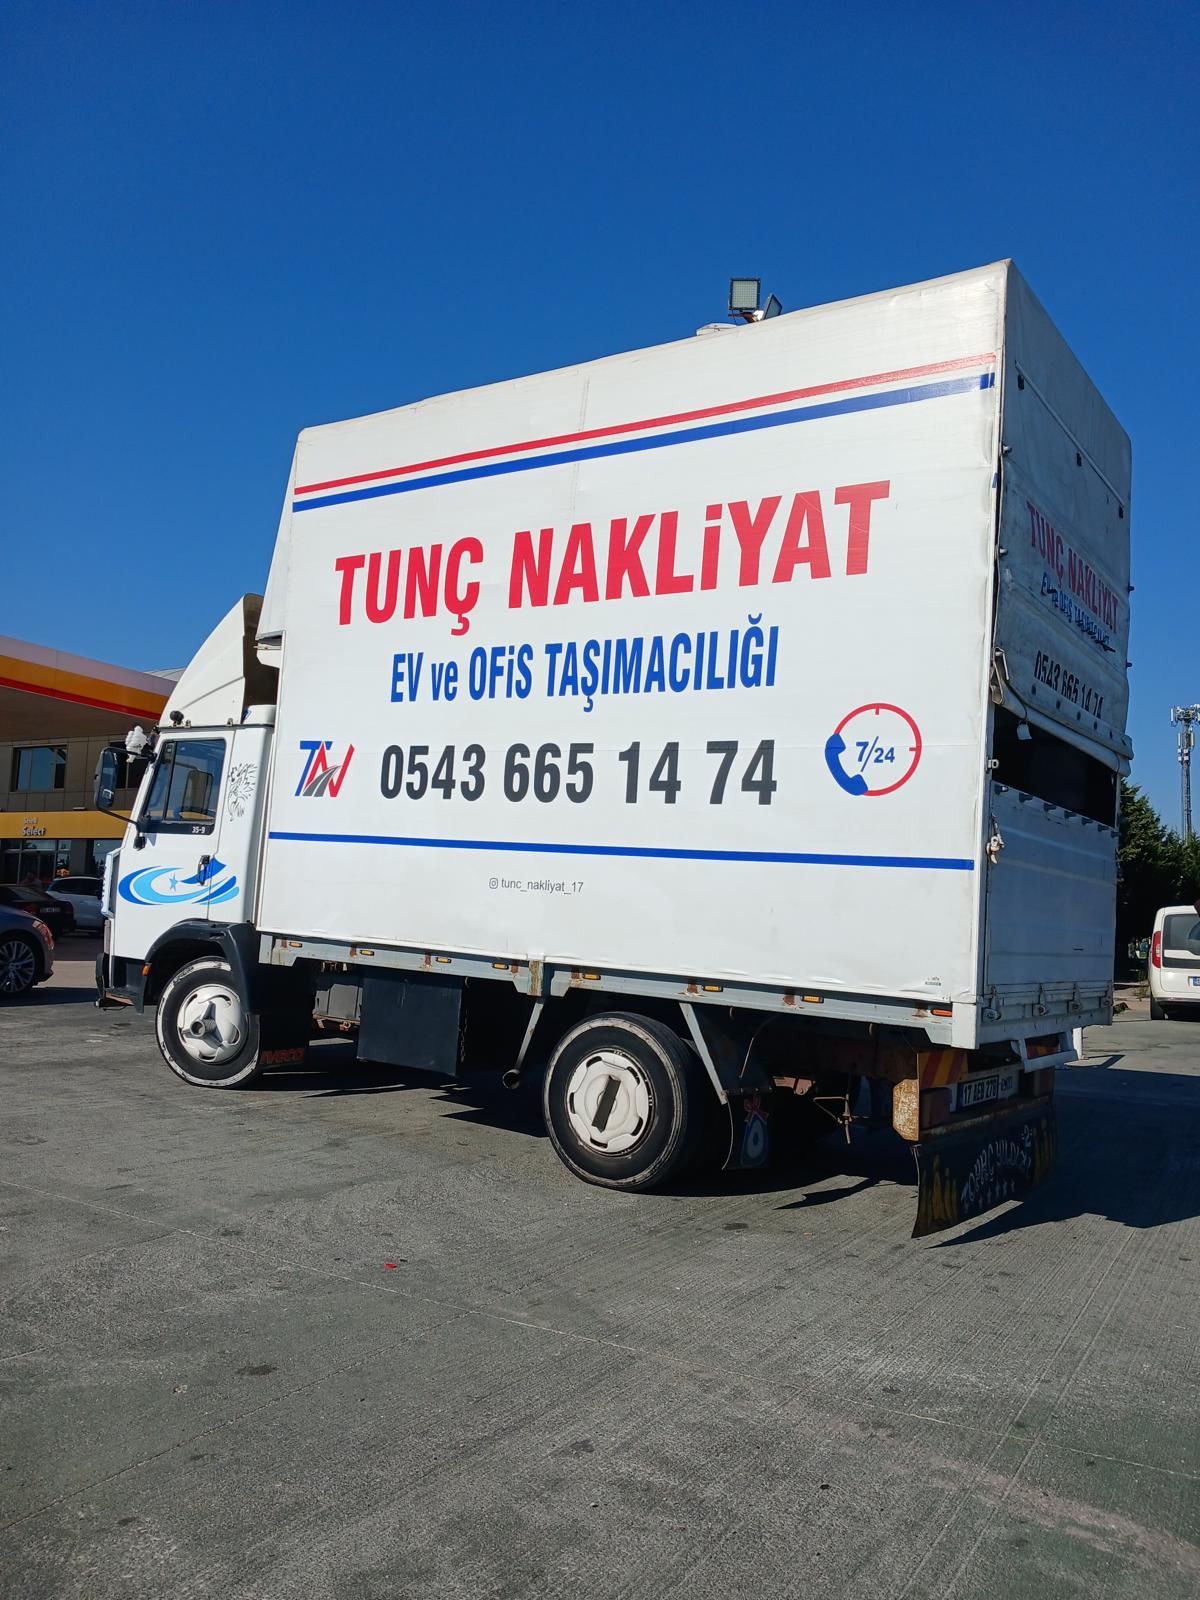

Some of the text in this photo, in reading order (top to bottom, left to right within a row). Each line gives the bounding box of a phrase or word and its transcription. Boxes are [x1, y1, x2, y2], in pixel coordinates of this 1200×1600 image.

[1026, 500, 1064, 589] TUNÇ
[335, 537, 484, 636] TUNÇ
[391, 652, 424, 702] EV
[431, 661, 458, 701] ve
[545, 613, 779, 712] TAŞIMACILIĞI
[1034, 650, 1104, 719] 0543 665 14 74
[380, 739, 777, 805] 0543 665 14 74
[856, 736, 895, 772] 7/24
[501, 878, 584, 894] tunc_nakliyat_17
